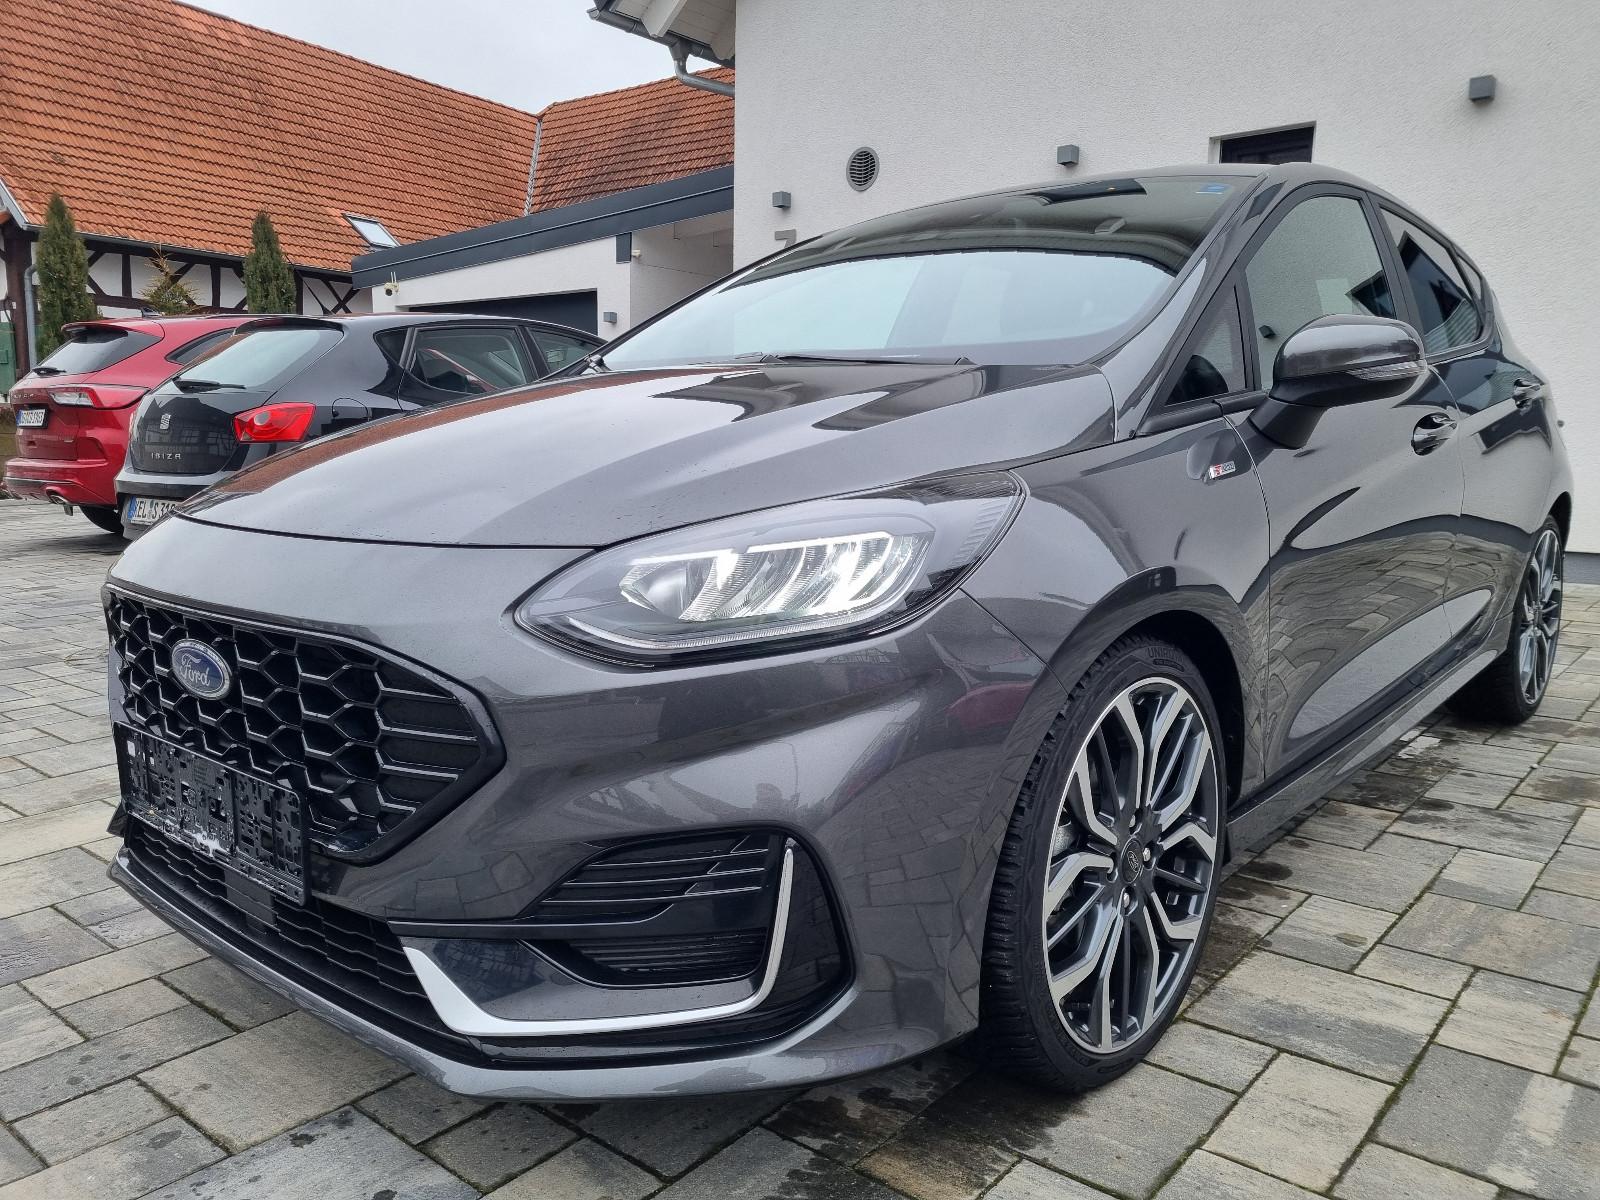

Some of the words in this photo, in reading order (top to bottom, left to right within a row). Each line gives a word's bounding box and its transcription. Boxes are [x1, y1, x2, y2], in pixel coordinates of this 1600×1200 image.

[151, 452, 181, 460] IBIZA
[152, 501, 159, 519] S
[179, 653, 211, 687] Ford
